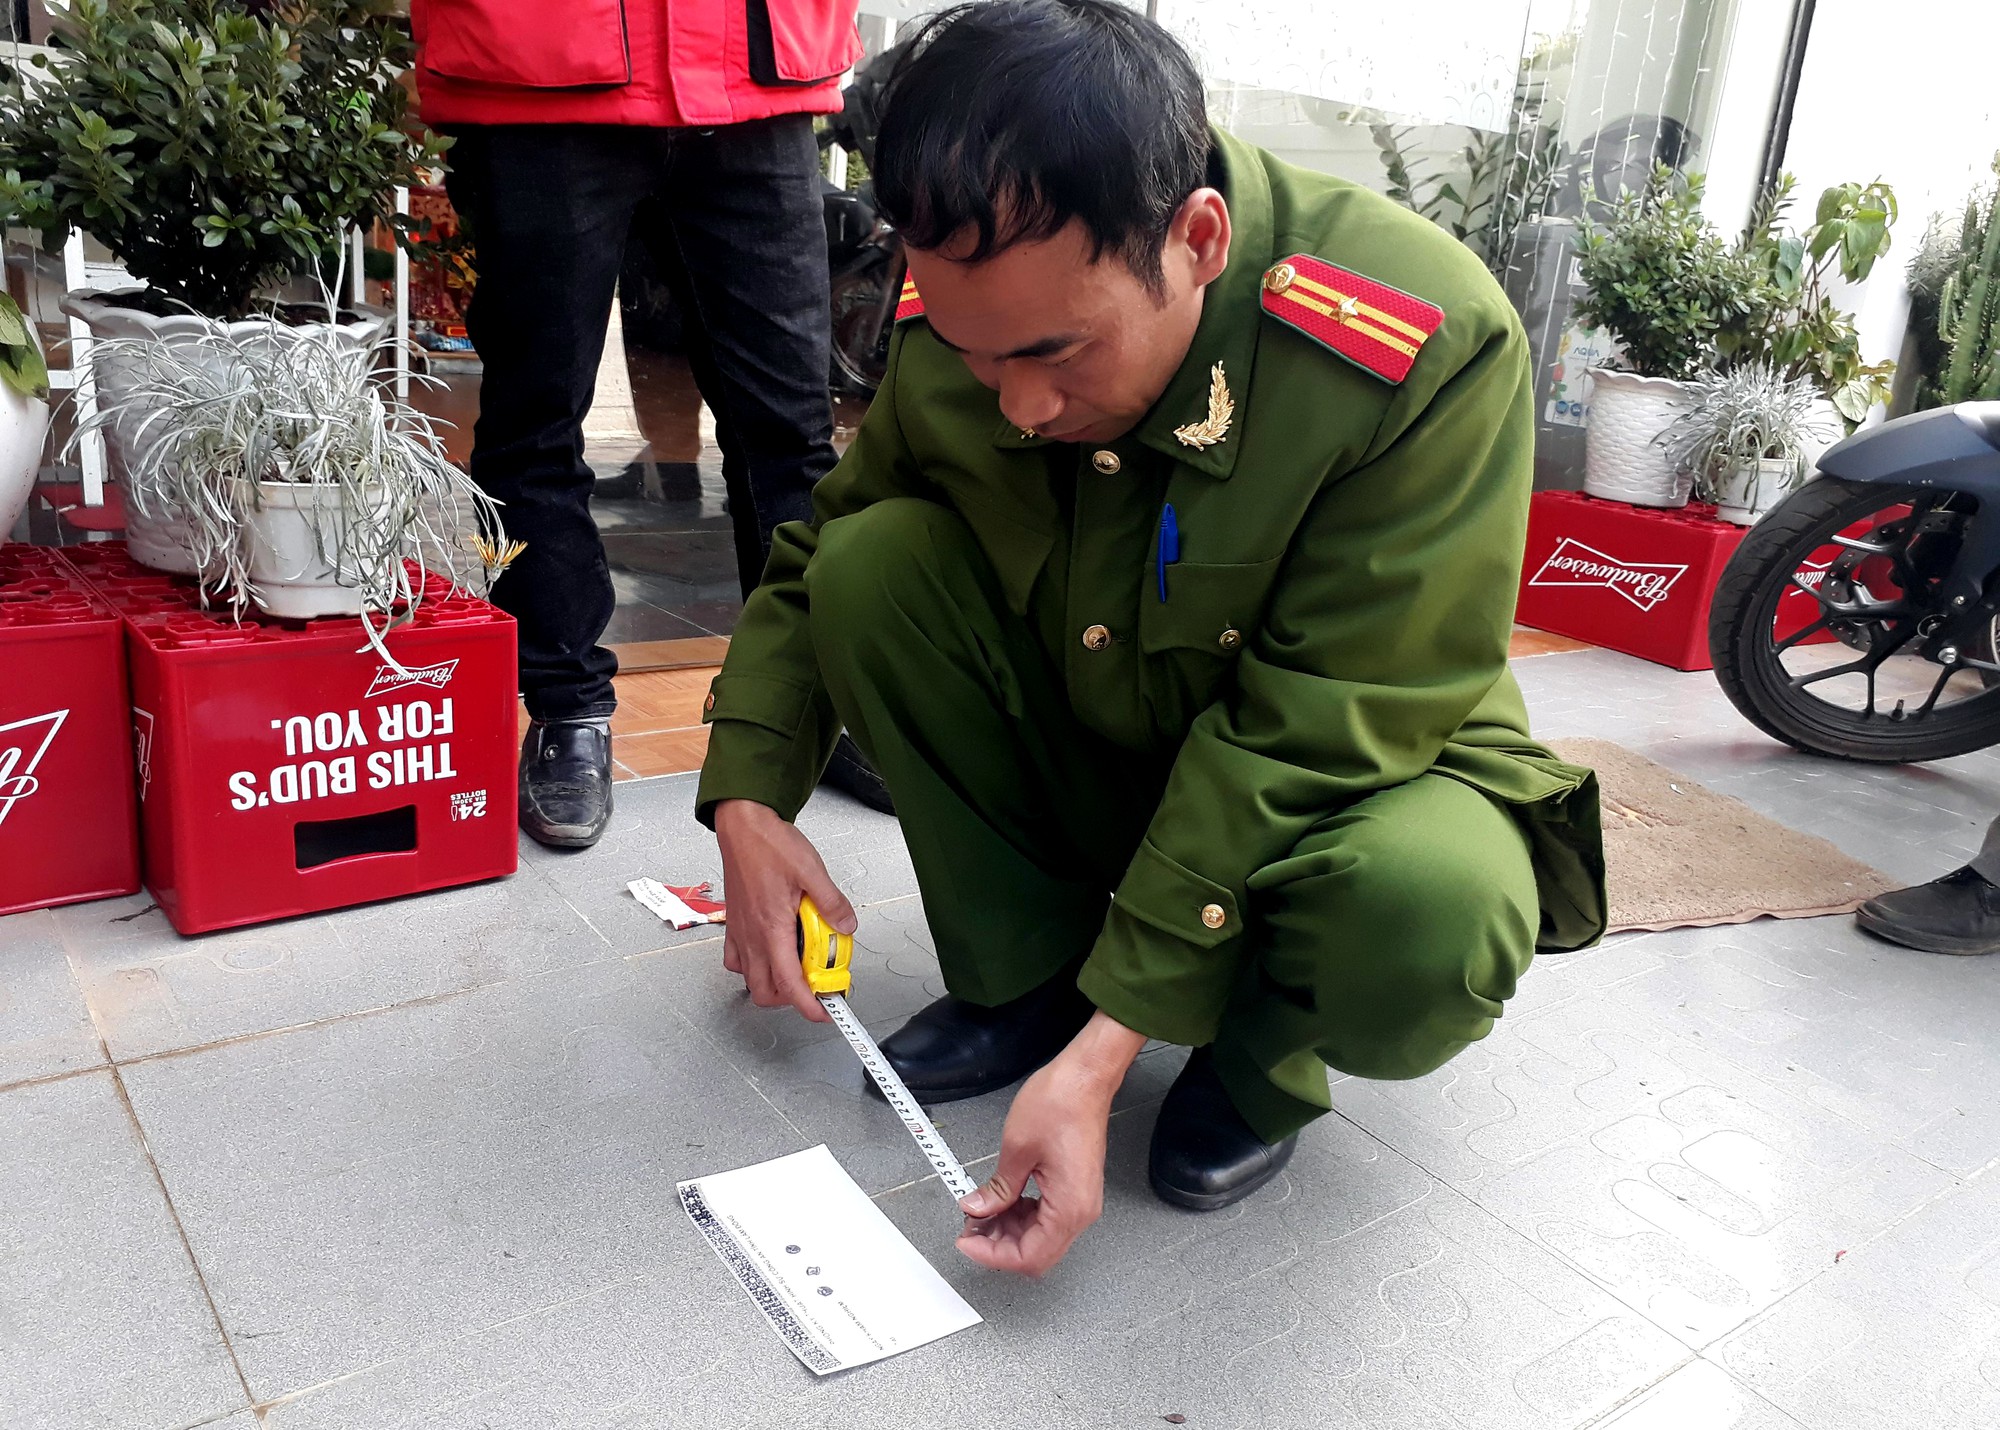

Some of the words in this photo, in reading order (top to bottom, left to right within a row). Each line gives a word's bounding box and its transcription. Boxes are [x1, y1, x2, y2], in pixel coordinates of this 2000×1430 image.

[1549, 556, 1668, 601] Budweiser
[271, 710, 368, 755] YOU.
[377, 698, 453, 741] FOR
[229, 756, 357, 811] BUD'S
[367, 743, 457, 789] THIS
[450, 789, 486, 801] BOTTLES
[458, 801, 487, 820] 24
